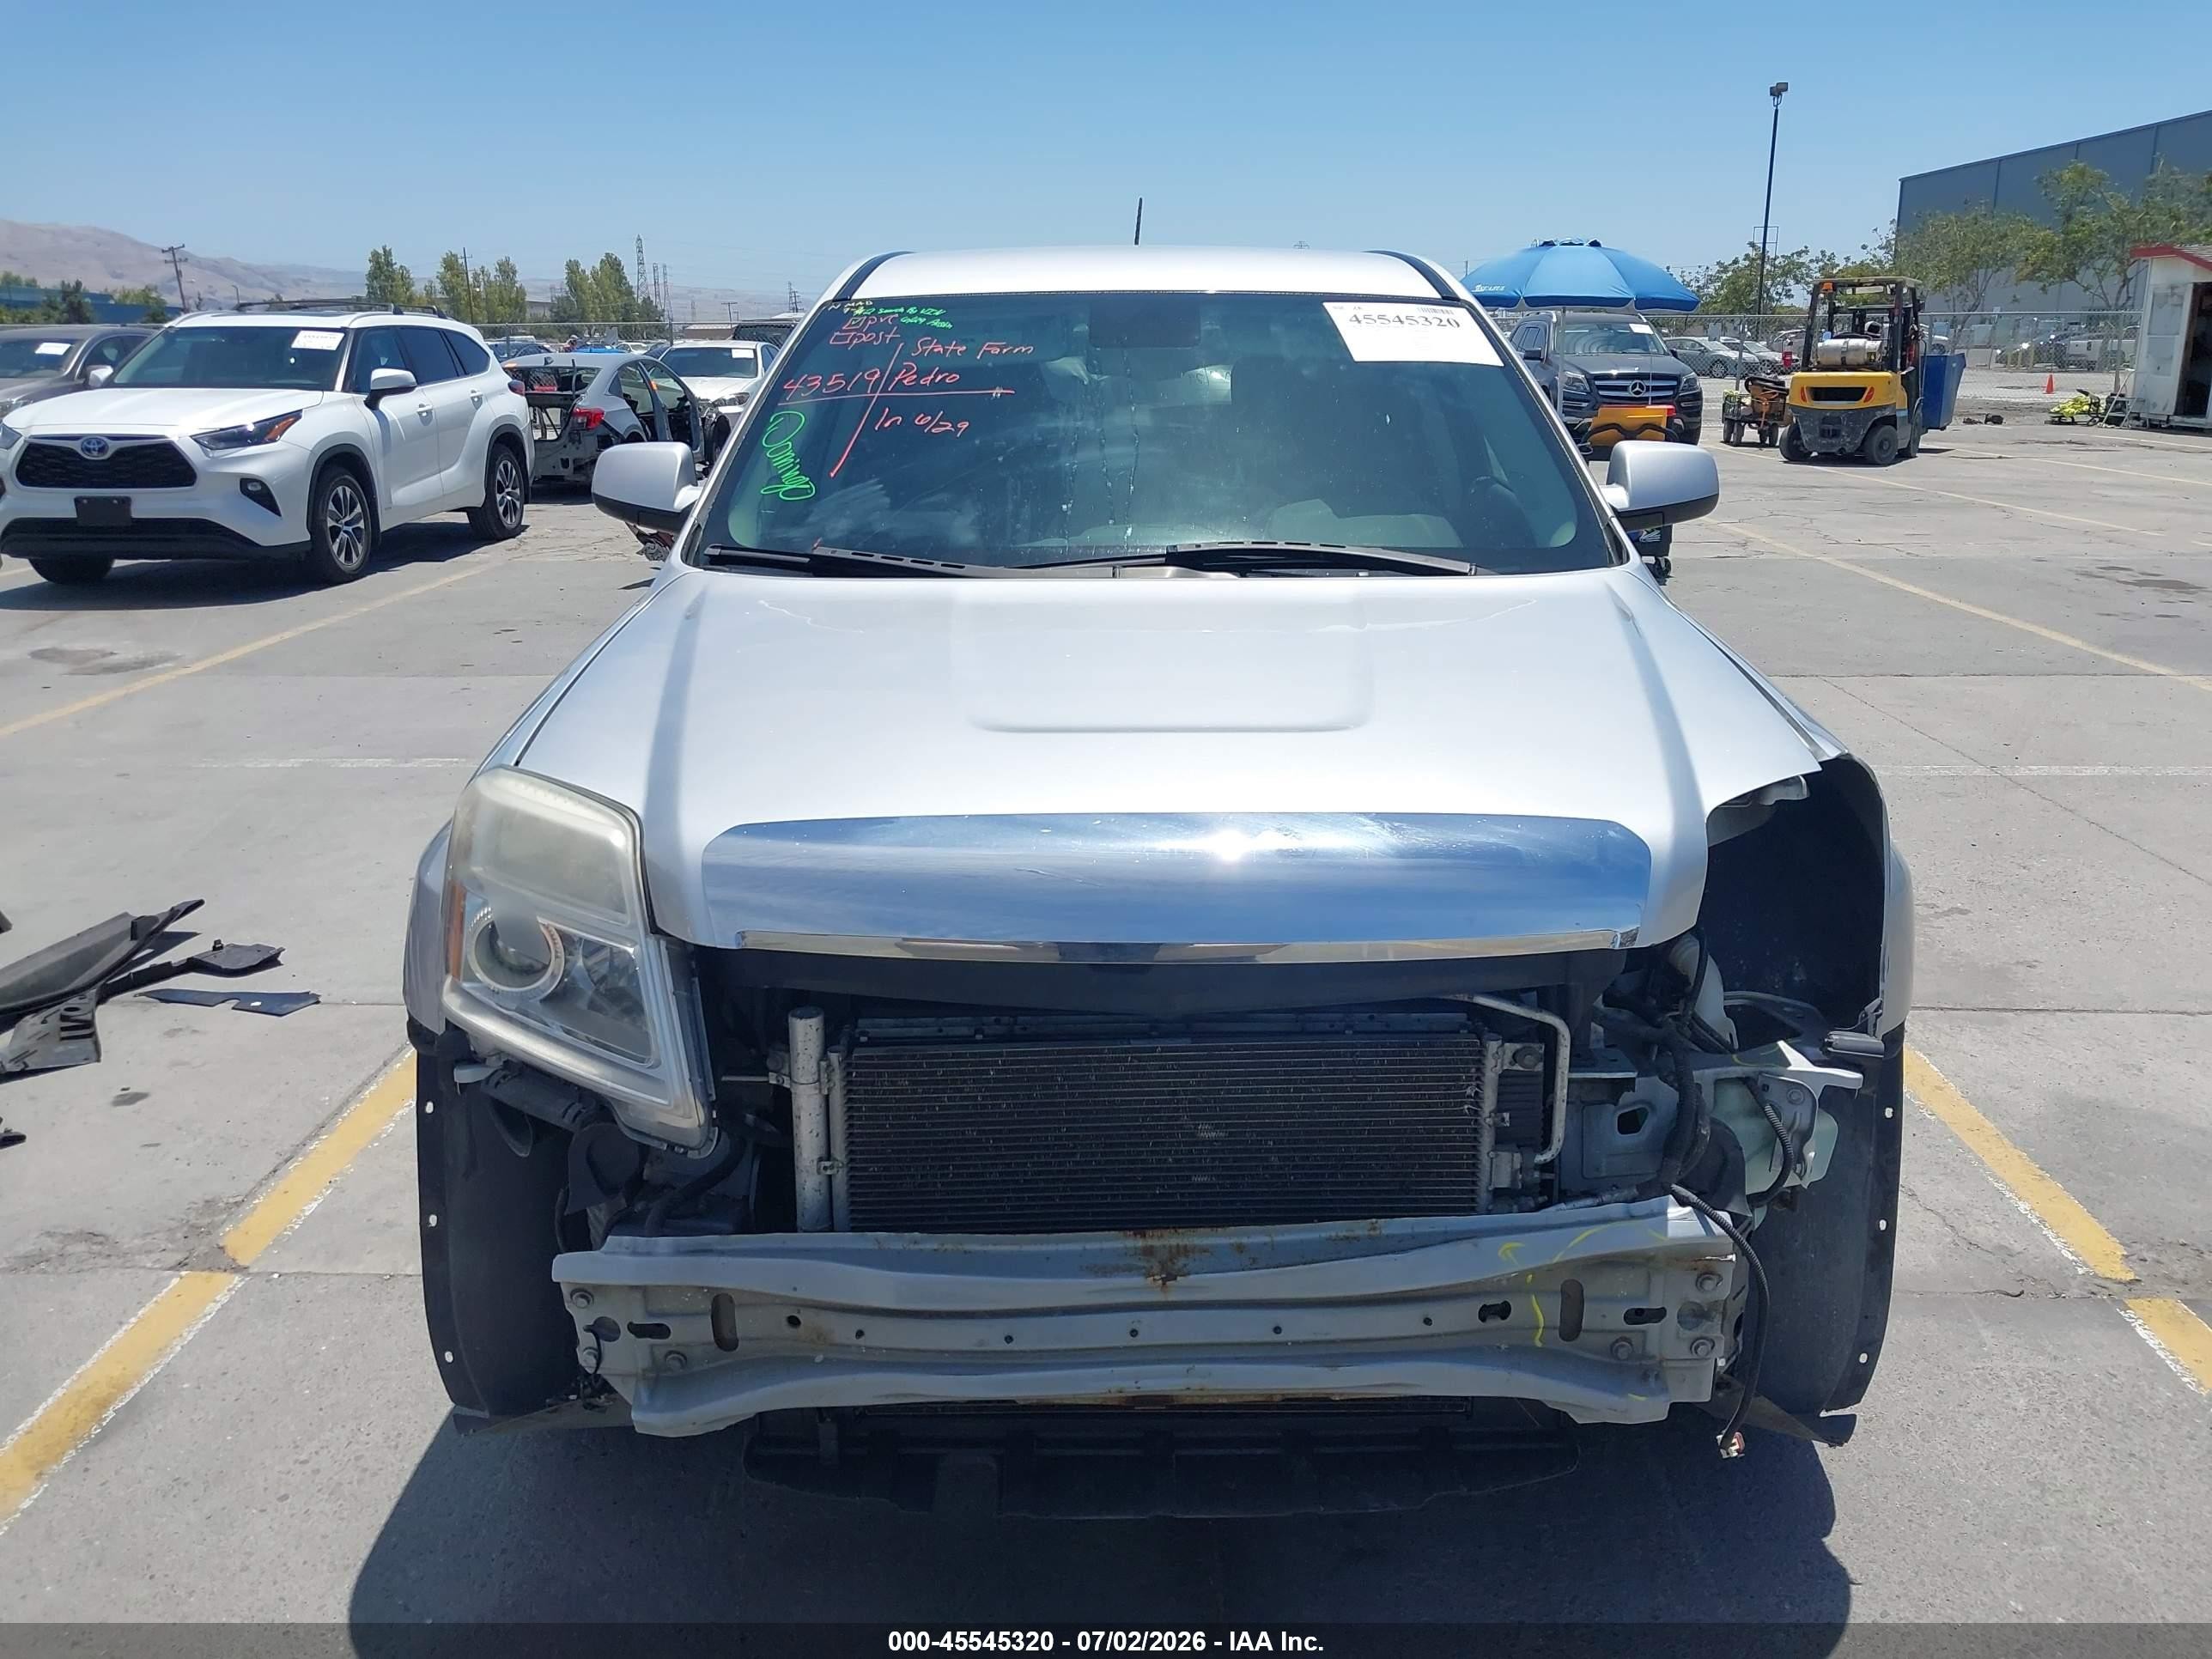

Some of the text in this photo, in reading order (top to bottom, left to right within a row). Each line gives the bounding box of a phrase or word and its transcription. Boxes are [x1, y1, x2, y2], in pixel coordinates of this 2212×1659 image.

[1349, 314, 1461, 328] 45545320
[911, 337, 1034, 359] State Farm
[888, 362, 960, 391] Pedro
